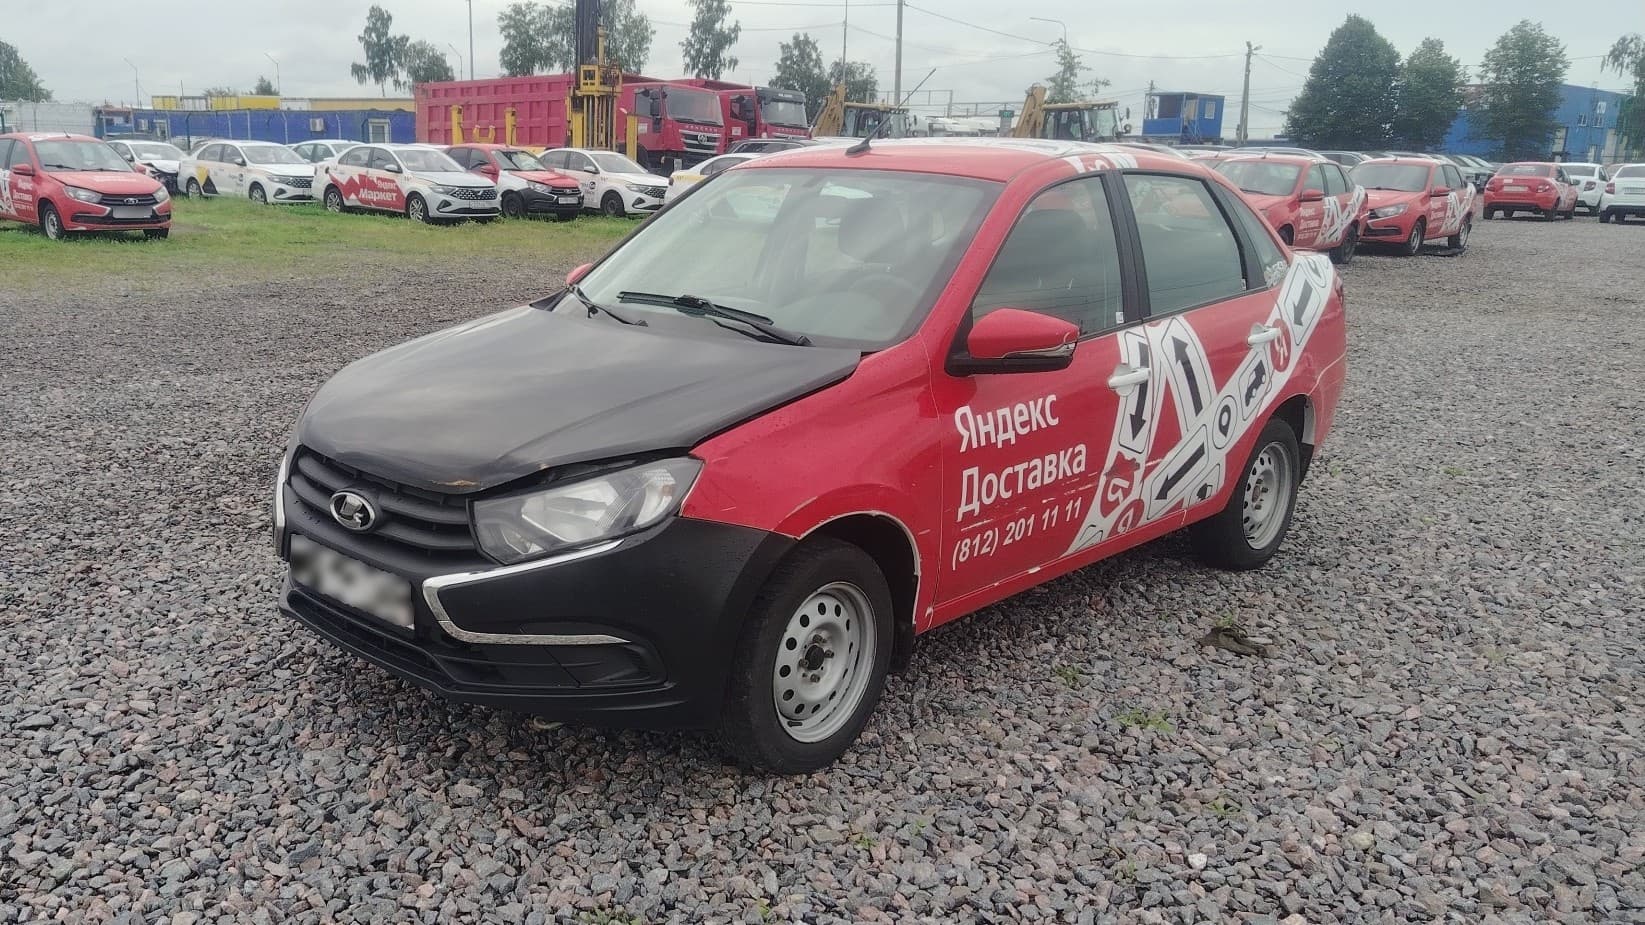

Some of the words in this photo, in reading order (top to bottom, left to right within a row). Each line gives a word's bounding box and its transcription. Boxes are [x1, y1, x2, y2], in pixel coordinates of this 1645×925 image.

[358, 187, 398, 201] Маркет
[954, 394, 1059, 453] Яндекс
[956, 443, 1087, 523] Доставка
[952, 527, 999, 571] (812)
[1002, 513, 1035, 546] 201
[1042, 505, 1059, 531] 11
[1065, 496, 1082, 522] 11
